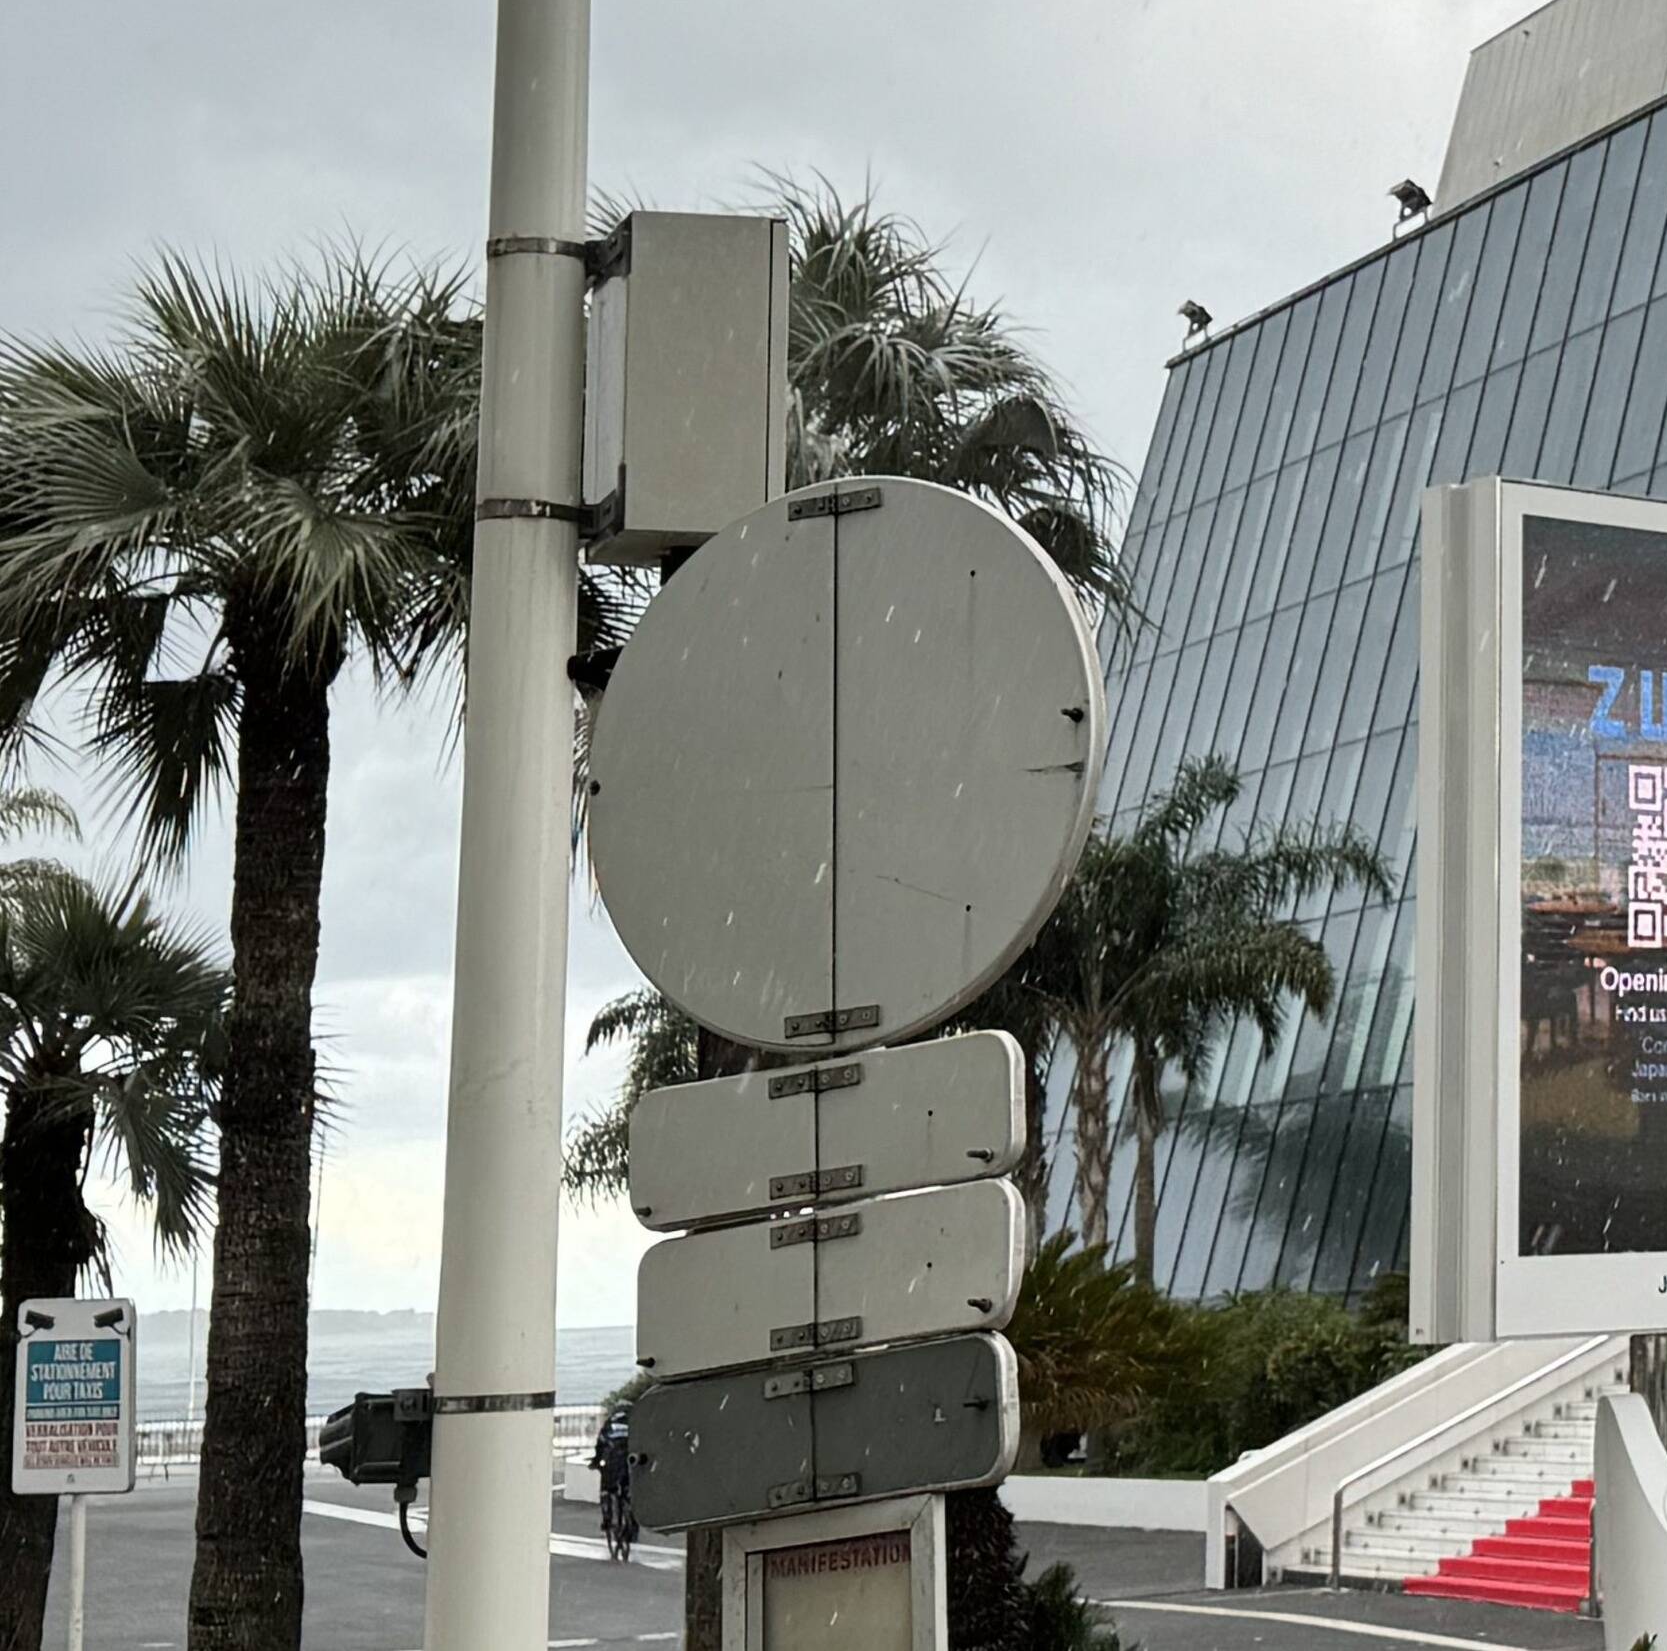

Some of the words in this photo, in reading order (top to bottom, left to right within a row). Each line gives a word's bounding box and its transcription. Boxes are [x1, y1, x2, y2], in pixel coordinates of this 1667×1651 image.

[1649, 1007, 1667, 1023] us
[54, 1342, 78, 1361] AIRE
[80, 1342, 94, 1361] DE
[31, 1361, 116, 1382] STATIONNEMENT
[43, 1382, 73, 1400] POUR
[73, 1381, 103, 1400] TAXIS
